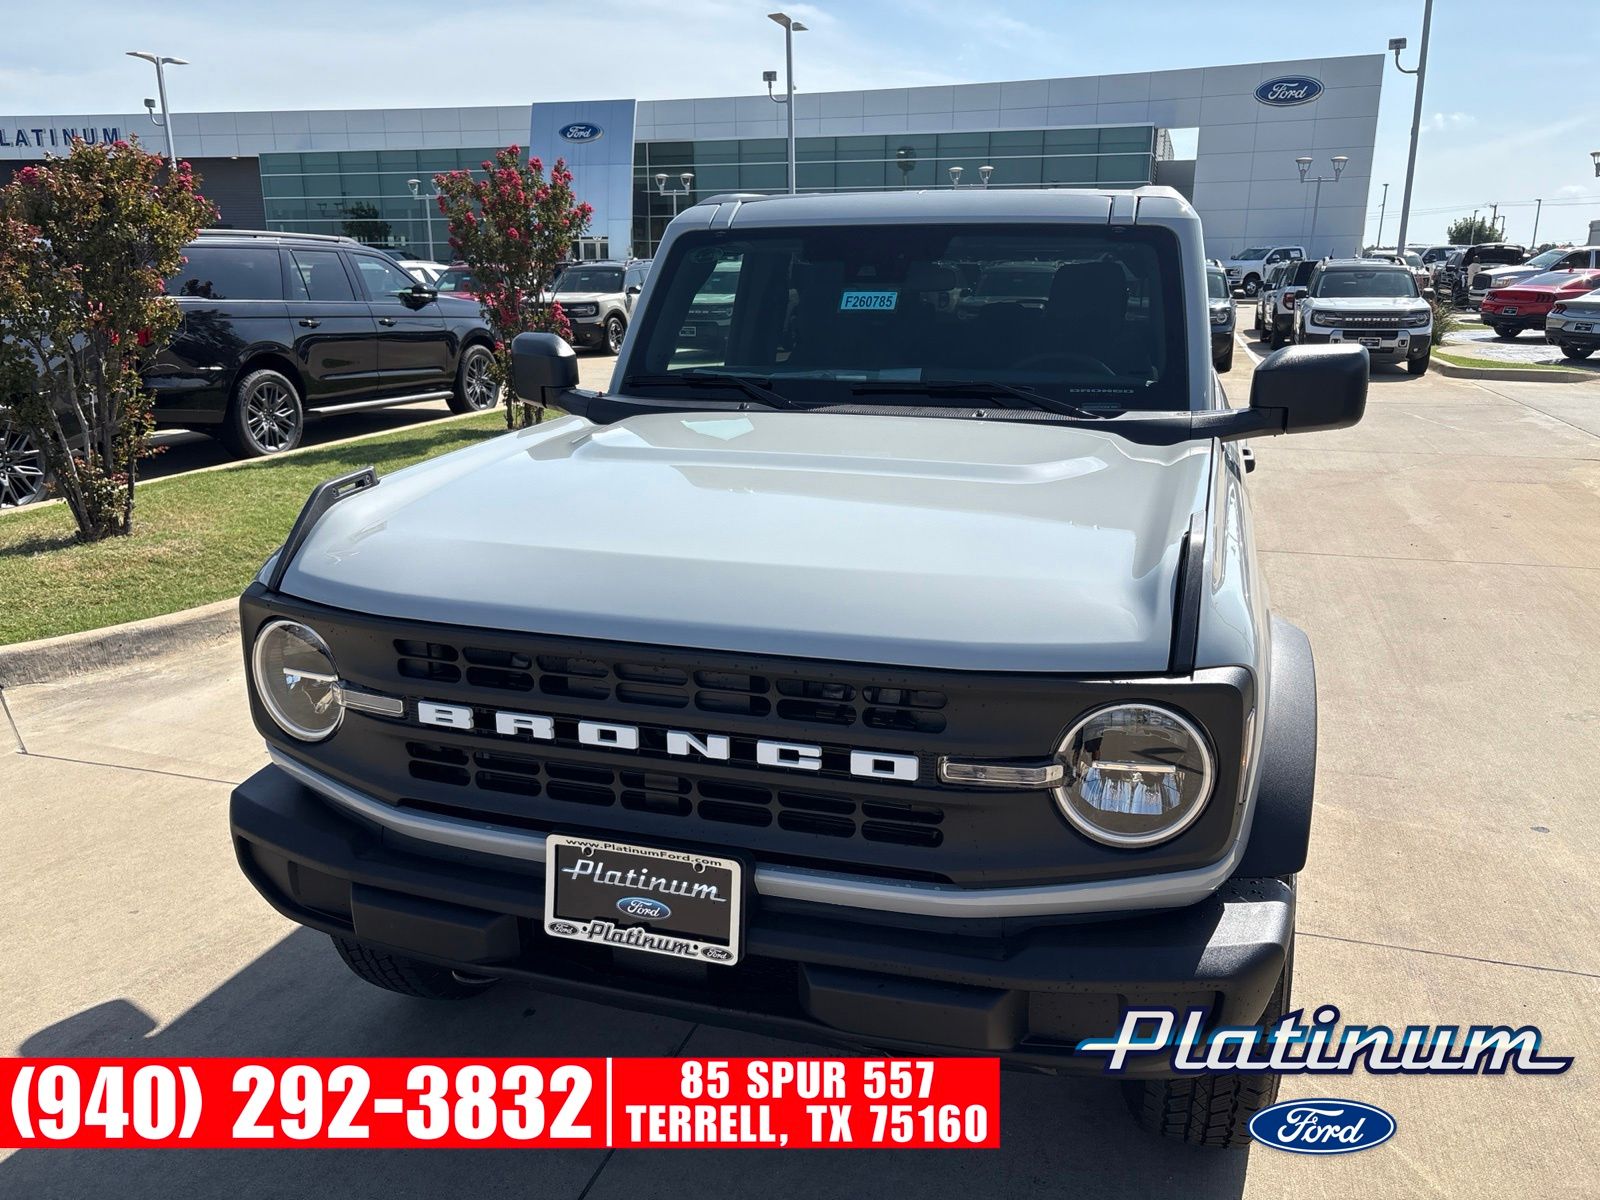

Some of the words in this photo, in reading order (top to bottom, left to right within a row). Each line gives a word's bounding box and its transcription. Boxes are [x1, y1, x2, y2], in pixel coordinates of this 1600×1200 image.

[1268, 82, 1308, 100] Ford
[566, 125, 592, 138] Ford
[845, 295, 893, 308] F260785
[418, 700, 919, 781] BRONCO
[565, 839, 722, 867] www.PlatinumFord.com
[561, 858, 727, 902] Platinum
[627, 900, 661, 918] Ford
[588, 920, 699, 956] Platinum
